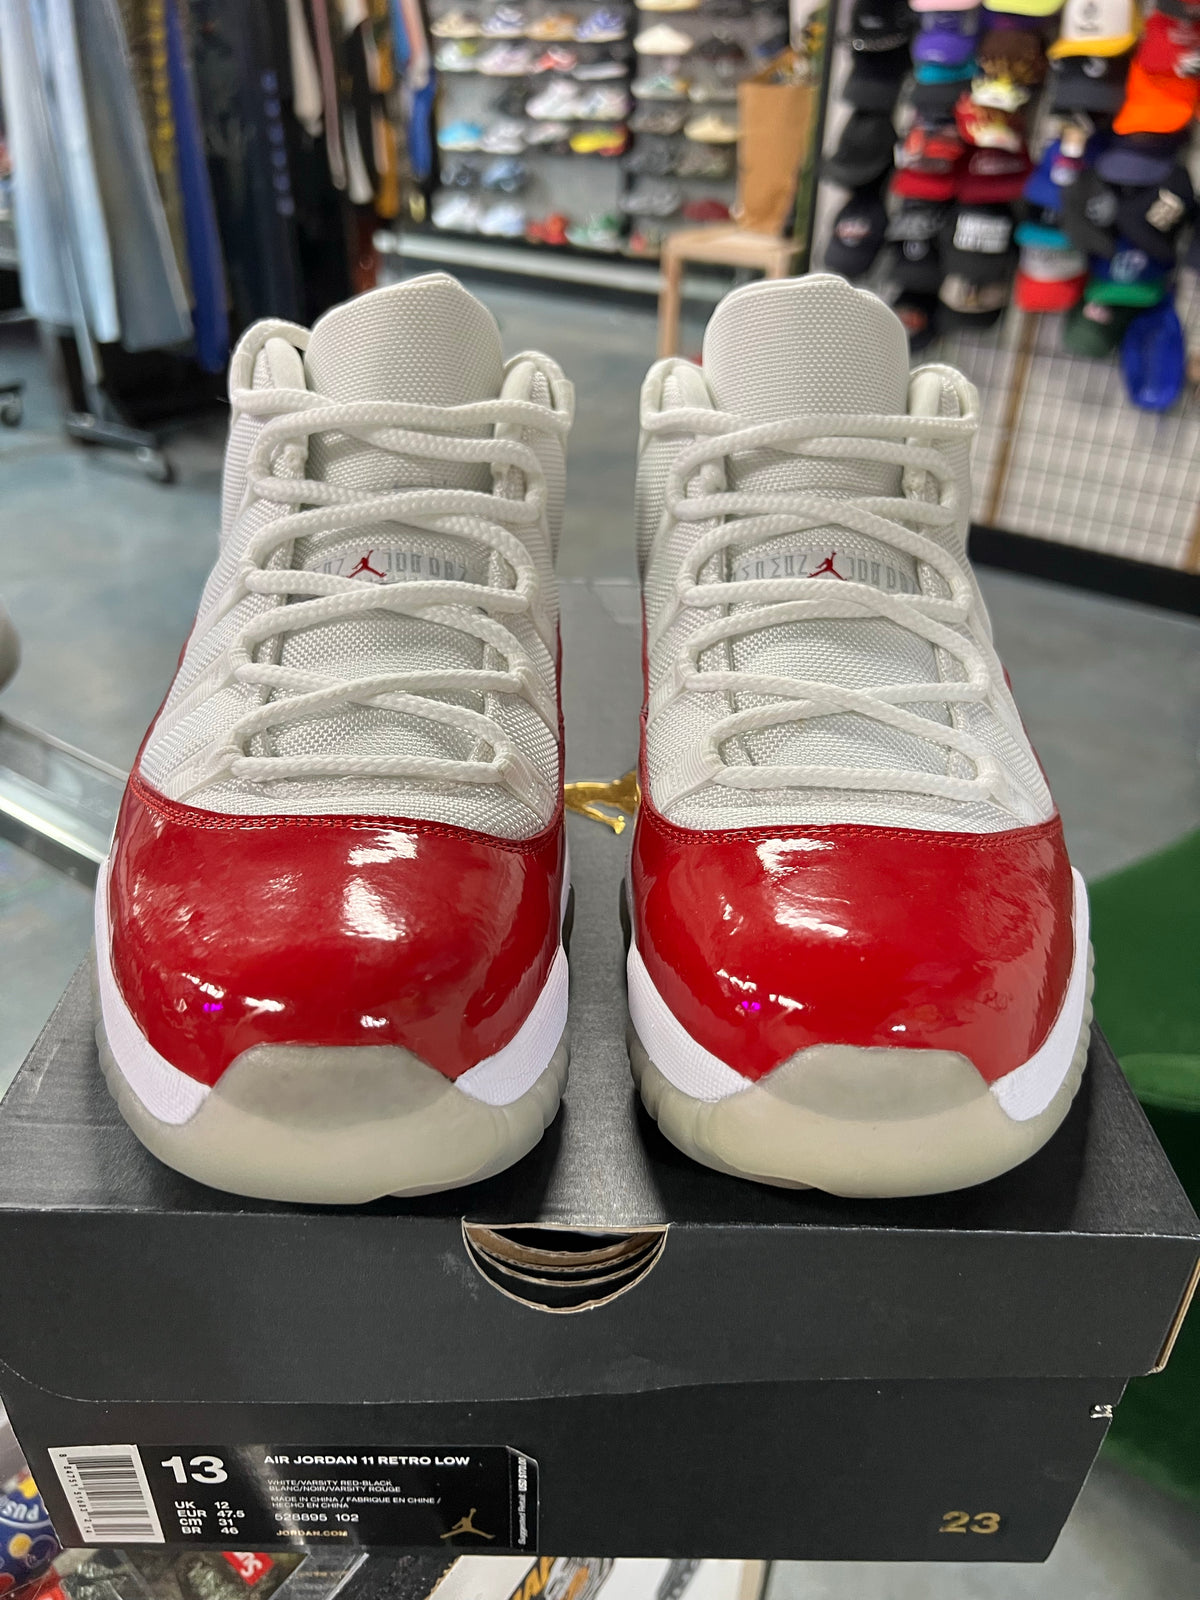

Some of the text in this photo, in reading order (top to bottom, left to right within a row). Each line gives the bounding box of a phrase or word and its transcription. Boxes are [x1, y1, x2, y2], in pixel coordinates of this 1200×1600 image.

[264, 1455, 470, 1466] AIR JORDAN 11 RETRO LOW
[161, 1455, 228, 1485] 13
[346, 1496, 391, 1504] FABRIQUE
[174, 1501, 230, 1510] UK 12
[177, 1509, 245, 1518] EUR 47.5
[274, 1513, 359, 1522] 528895 102
[179, 1518, 233, 1527] cm 31
[938, 1510, 1001, 1535] 23
[181, 1526, 239, 1535] BR 46
[276, 1529, 348, 1537] JORDAN.COM
